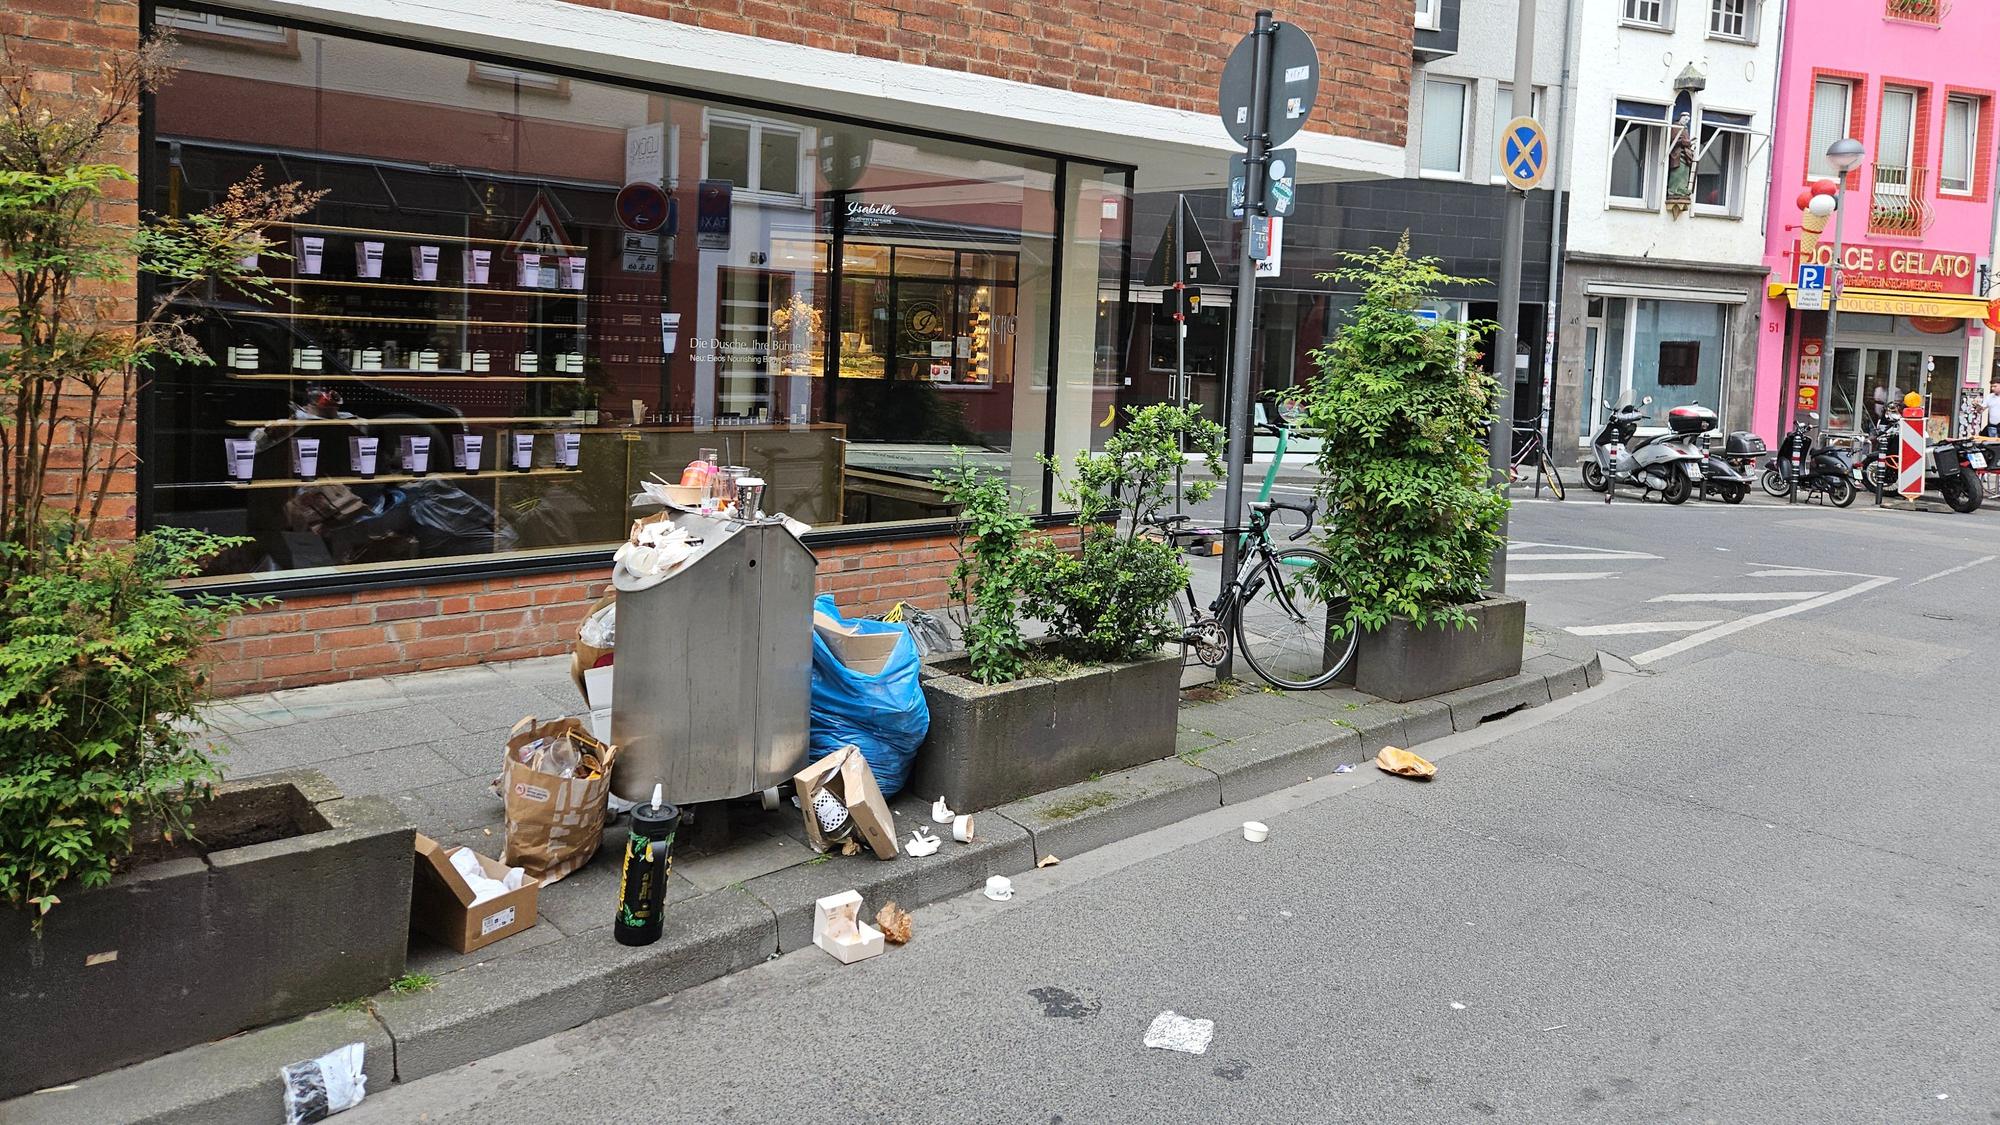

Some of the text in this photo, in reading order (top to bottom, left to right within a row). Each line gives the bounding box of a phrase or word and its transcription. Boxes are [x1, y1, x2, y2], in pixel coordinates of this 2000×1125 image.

[1805, 244, 1971, 278] DOCE & GELATO
[1802, 267, 1818, 289] P
[1841, 299, 1940, 315] DOLCE & GELATO
[1769, 322, 1779, 333] 51
[689, 337, 708, 349] Die
[710, 338, 748, 350] Dusche,
[752, 339, 768, 350] Ihre
[689, 354, 706, 362] Neu:
[727, 355, 762, 364] Nourishing
